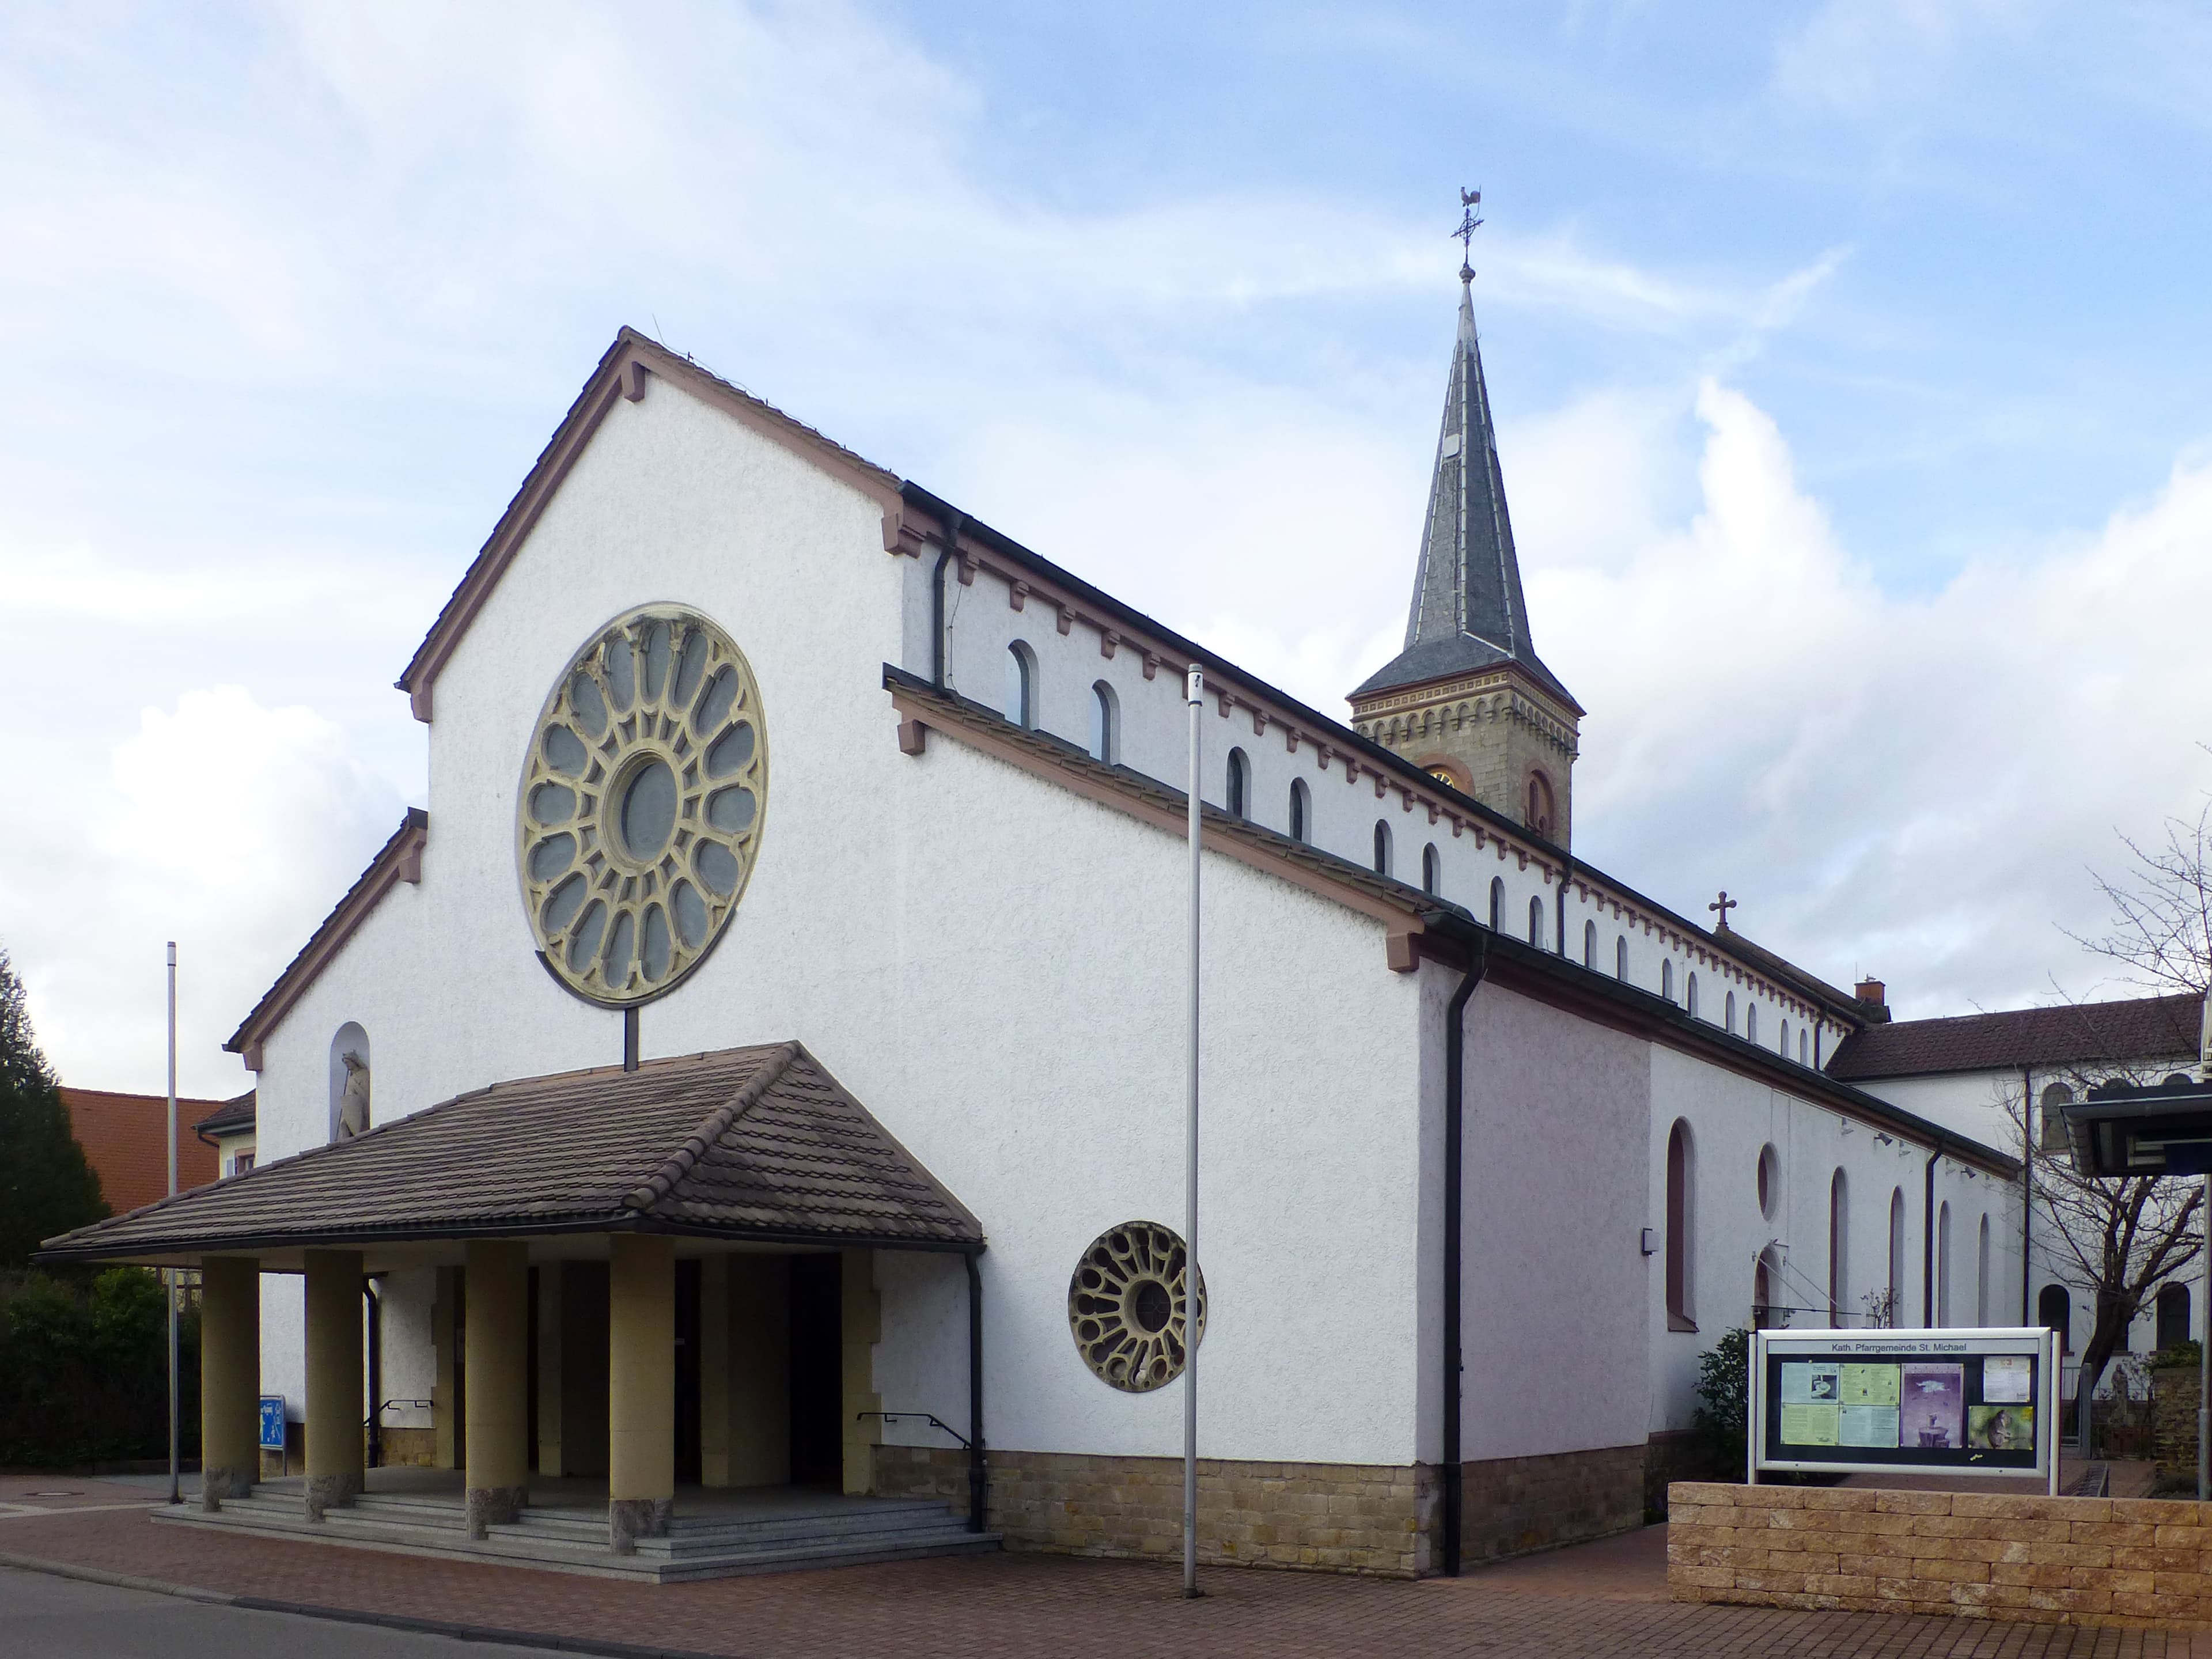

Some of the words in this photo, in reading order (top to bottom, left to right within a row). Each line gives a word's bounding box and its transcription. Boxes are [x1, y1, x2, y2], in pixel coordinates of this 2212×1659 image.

[1832, 1343, 1853, 1351] Kath.
[1855, 1343, 1916, 1353] Pfarrgemeinde
[1919, 1343, 1930, 1351] St.
[1933, 1343, 1967, 1351] Michael
